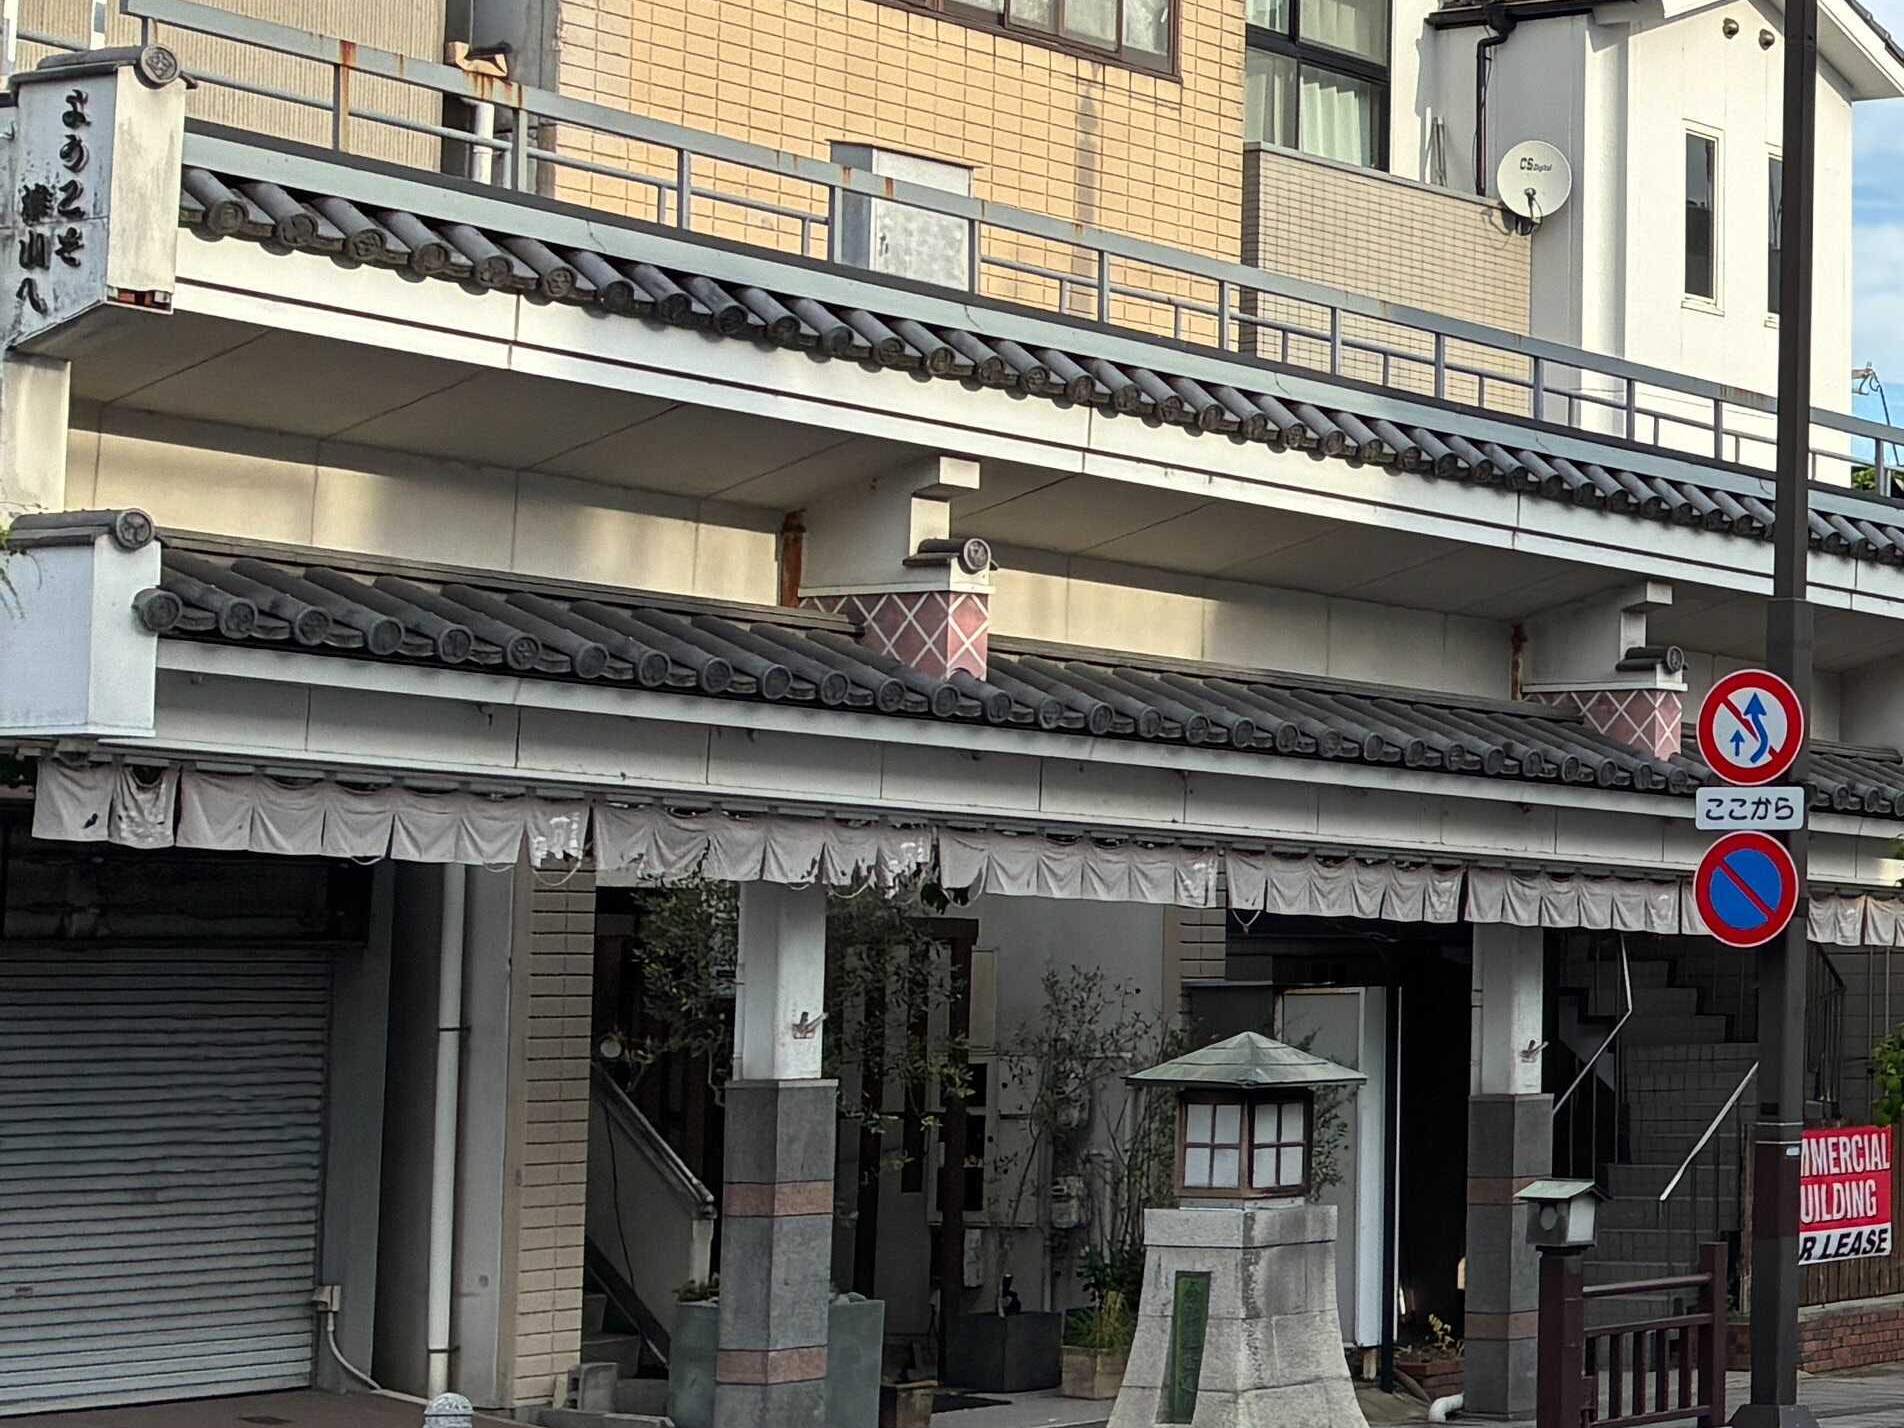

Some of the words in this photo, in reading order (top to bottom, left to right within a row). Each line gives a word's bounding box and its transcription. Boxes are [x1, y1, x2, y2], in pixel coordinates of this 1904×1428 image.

[55, 88, 92, 268] ようこそ
[1706, 795, 1794, 821] ここから
[1800, 1178, 1877, 1224] UILDING
[1818, 1227, 1889, 1260] LEASE
